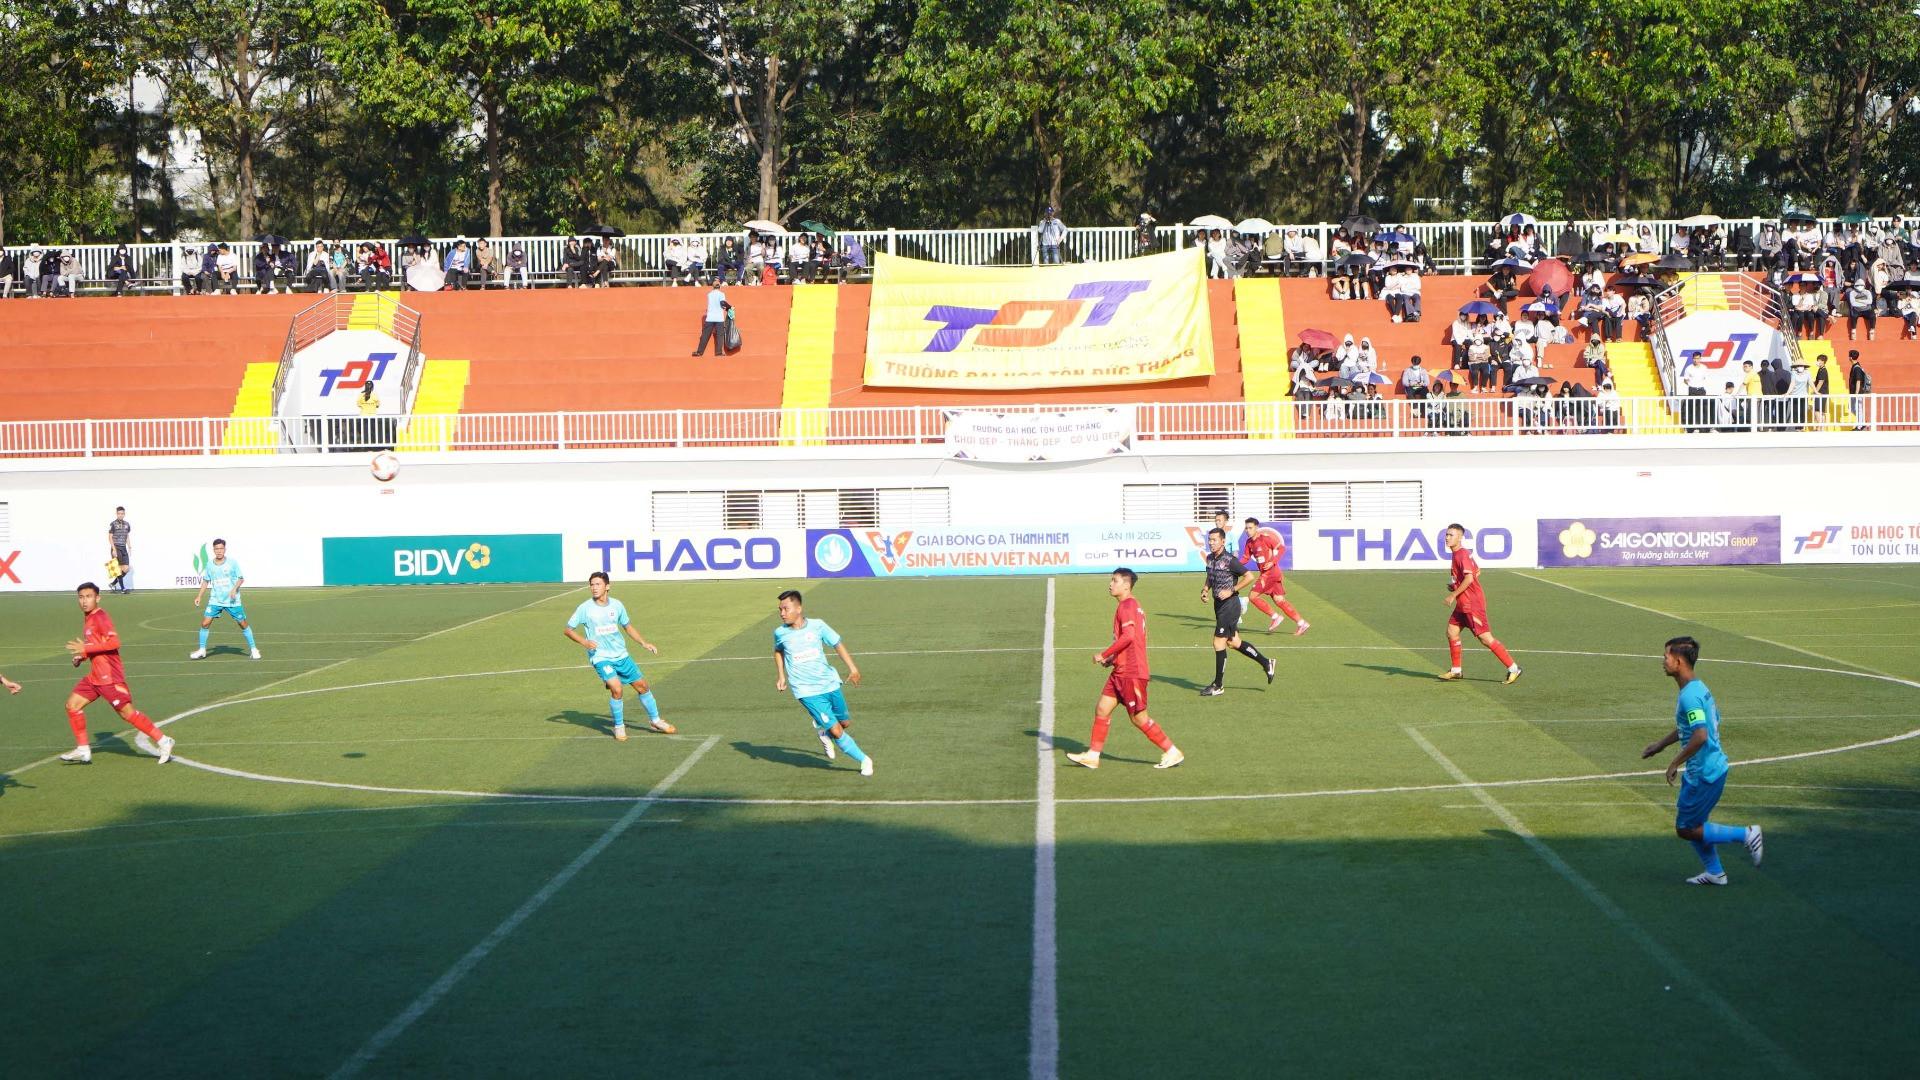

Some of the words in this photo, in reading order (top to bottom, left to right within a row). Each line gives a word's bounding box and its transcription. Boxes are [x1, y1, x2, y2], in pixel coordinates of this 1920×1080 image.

[923, 280, 1151, 352] TDT
[319, 352, 398, 397] TDT
[1137, 531, 1162, 540] 2025
[1318, 527, 1513, 562] THACO
[1600, 532, 1731, 548] SAIGONTOURIST
[1731, 537, 1758, 547] GROUP
[1793, 525, 1844, 555] TDT
[394, 549, 466, 576] BIDV
[588, 537, 781, 573] THACO
[906, 552, 946, 568] SINH
[1028, 551, 1070, 566] NAM
[1114, 548, 1178, 559] THACO
[1689, 711, 1697, 721] C
